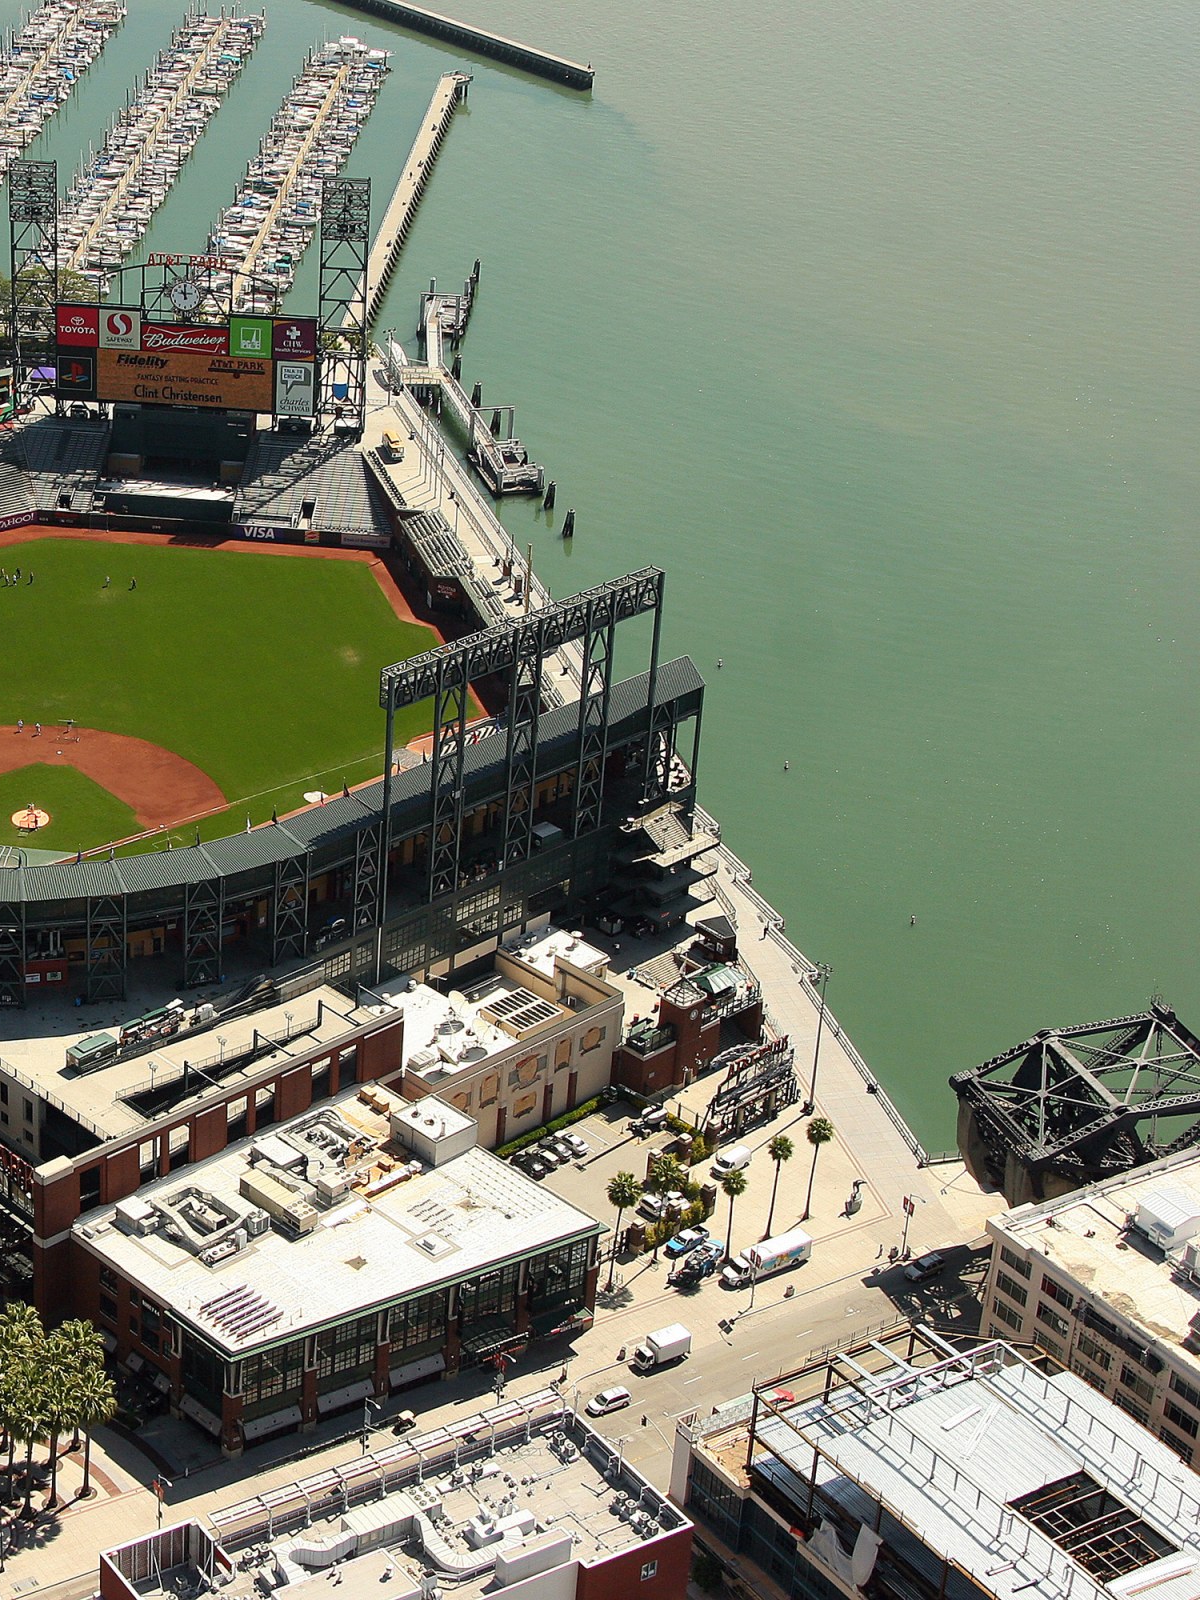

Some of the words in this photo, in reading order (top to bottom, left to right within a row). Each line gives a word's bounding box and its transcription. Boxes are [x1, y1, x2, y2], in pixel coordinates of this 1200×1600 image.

[145, 252, 183, 267] AT&T
[188, 254, 229, 271] PARK
[59, 325, 96, 335] TOYOTA
[142, 333, 226, 347] Budweiser
[283, 340, 303, 348] CHW
[116, 354, 170, 369] Fidelity
[210, 359, 236, 369] AT&T
[237, 361, 265, 371] PARK
[136, 373, 163, 382] FANTASY
[164, 375, 188, 383] BATTING
[188, 376, 219, 385] PRACTICE
[134, 384, 159, 399] Clint
[161, 386, 222, 403] Christensen
[280, 397, 310, 406] charles
[243, 527, 275, 539] VISA
